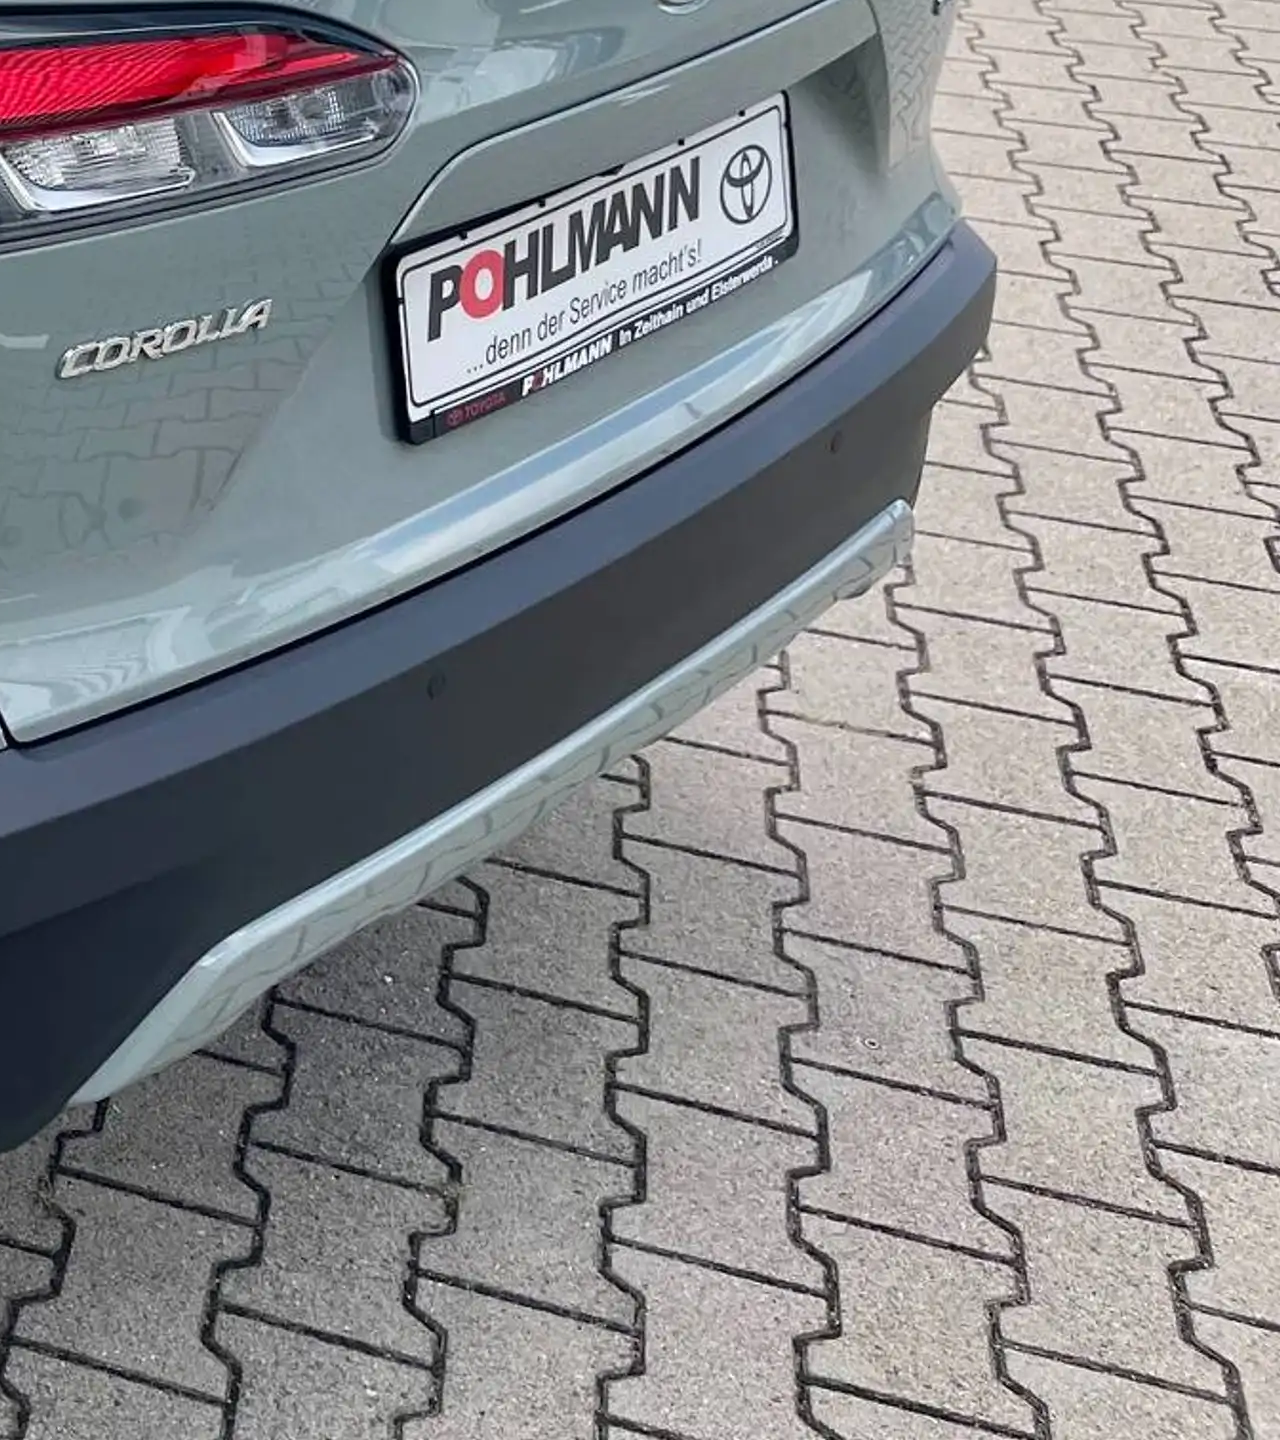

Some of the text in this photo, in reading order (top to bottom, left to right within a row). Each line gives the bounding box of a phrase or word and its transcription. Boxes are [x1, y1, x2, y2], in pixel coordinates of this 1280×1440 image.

[427, 156, 701, 342] POHLMANN
[537, 310, 566, 341] der
[569, 278, 628, 326] Service
[632, 238, 703, 294] macht's!
[55, 297, 273, 379] COROLLA
[521, 334, 614, 397] POHLMANN
[634, 302, 684, 339] Zeithain
[686, 290, 709, 314] und
